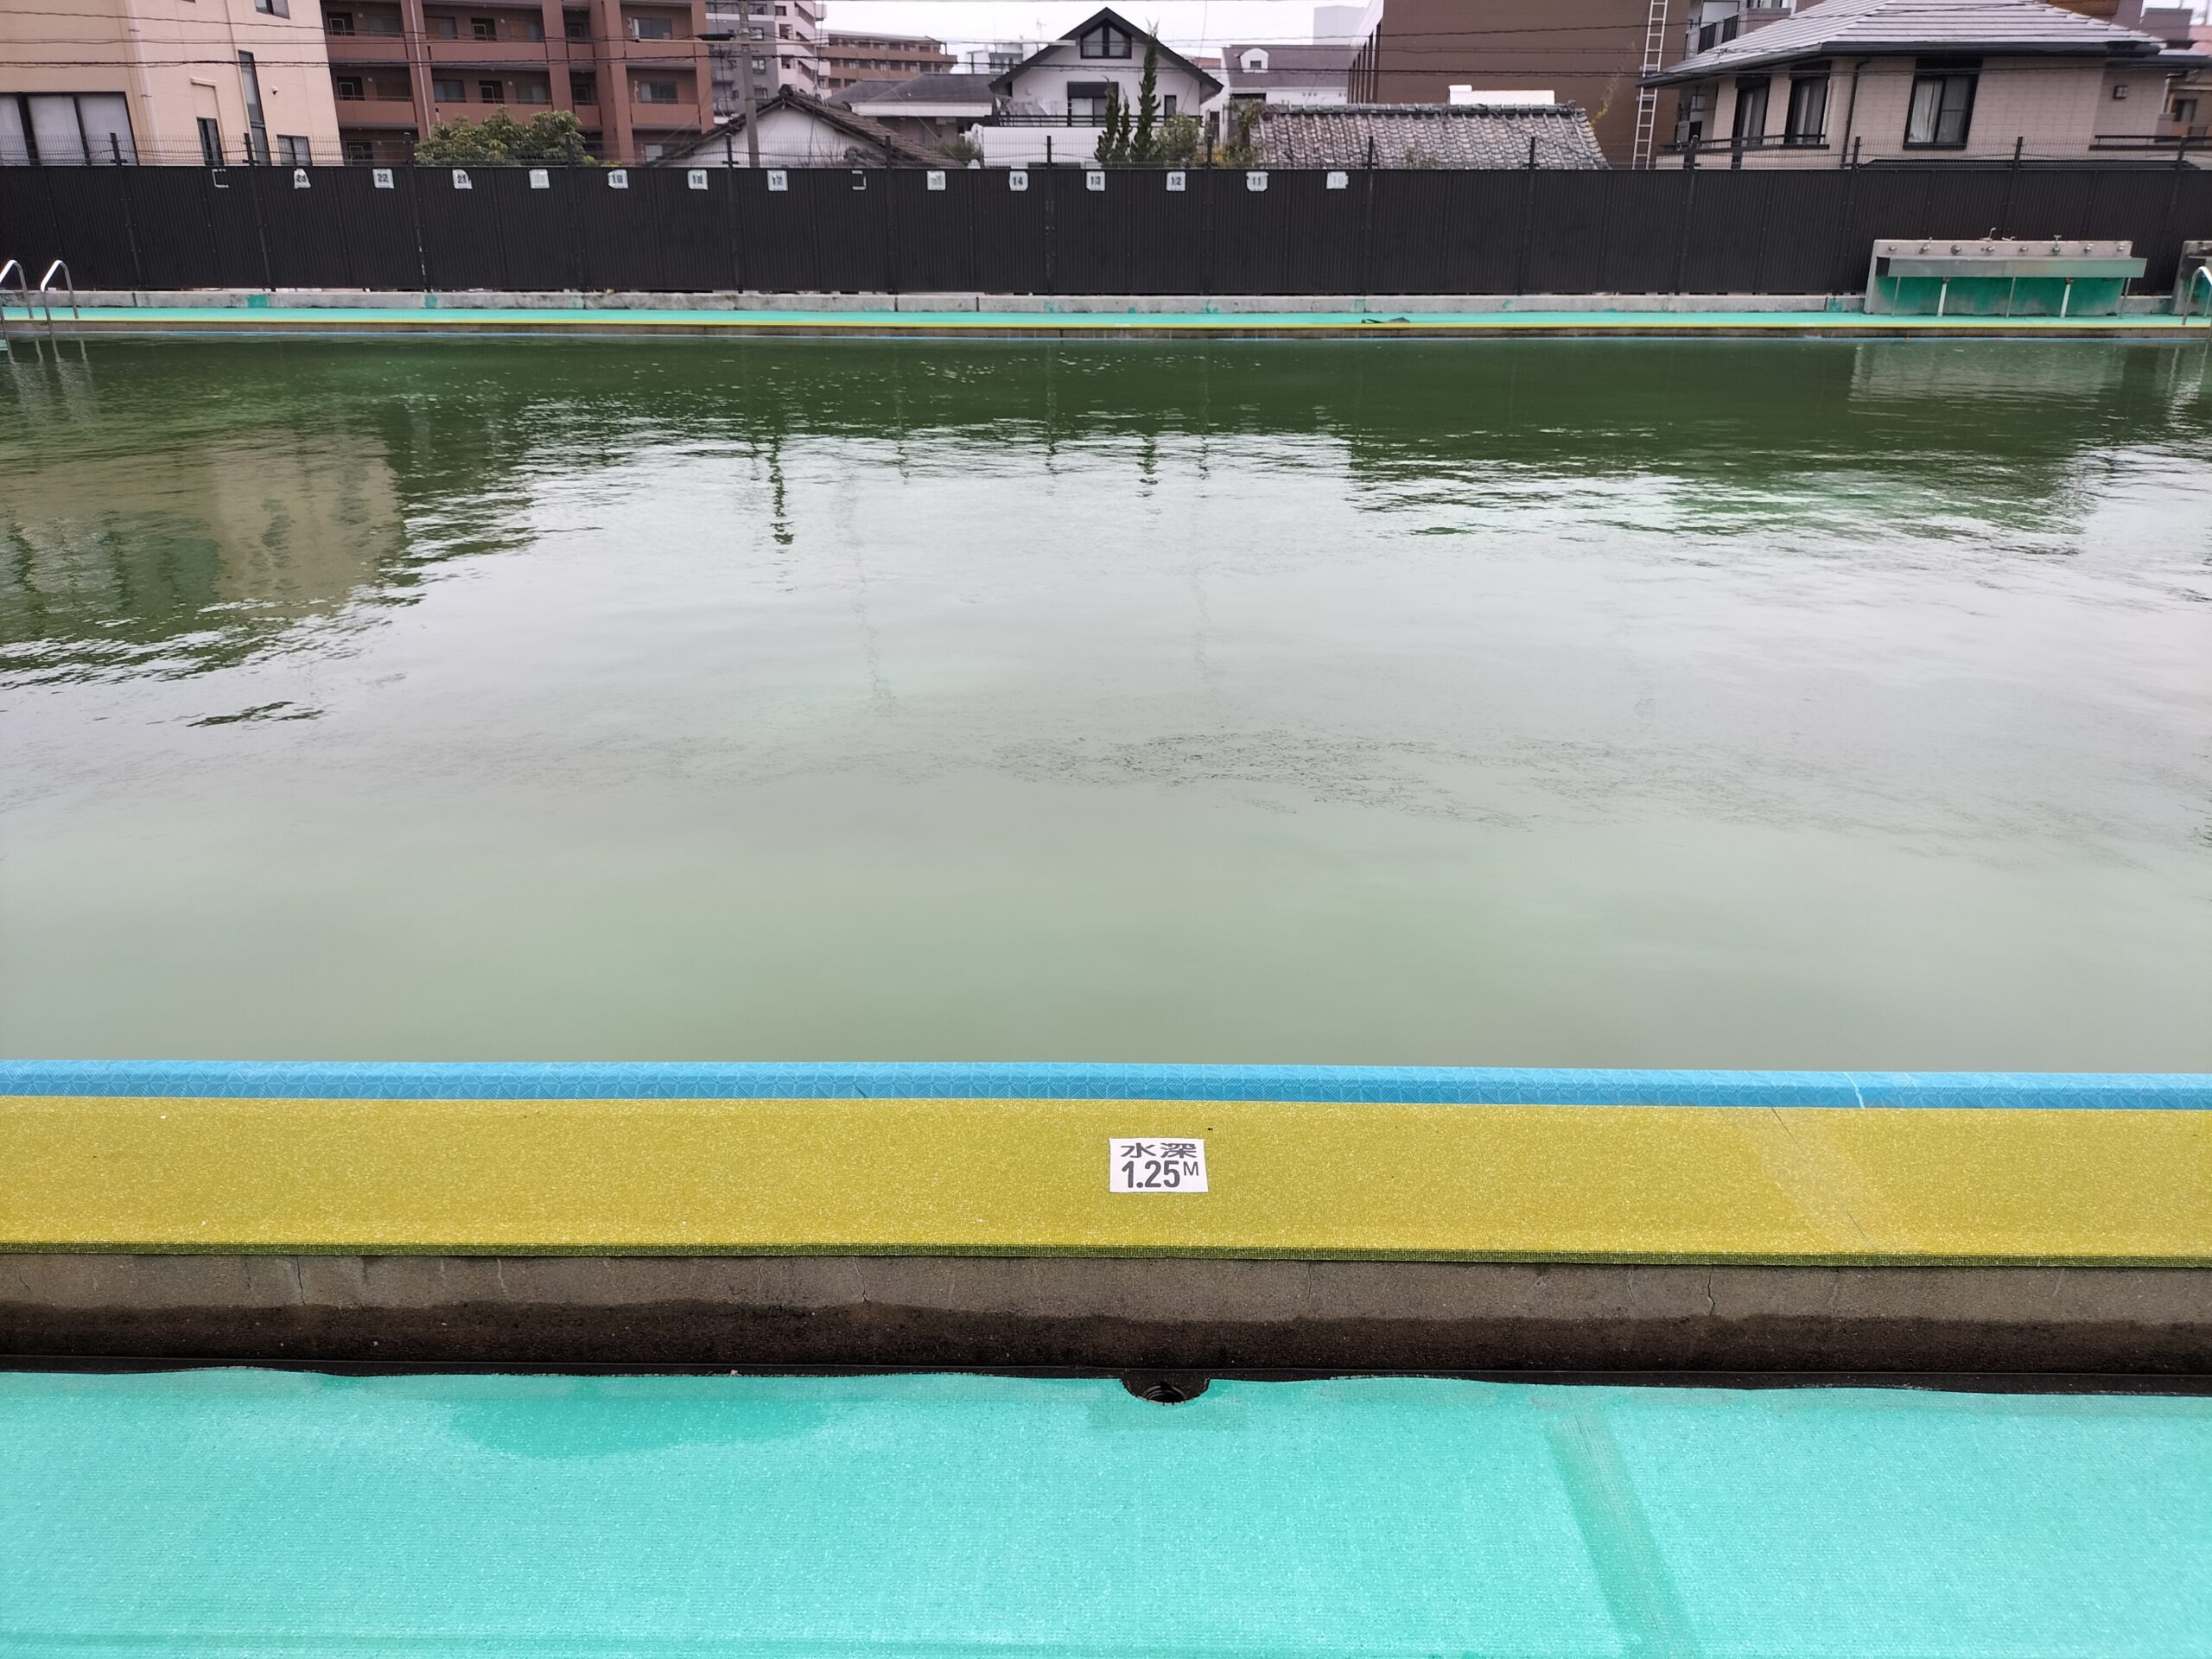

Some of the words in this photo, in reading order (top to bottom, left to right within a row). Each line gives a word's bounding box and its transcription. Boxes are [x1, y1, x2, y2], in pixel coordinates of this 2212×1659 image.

[378, 174, 388, 182] 22
[457, 175, 467, 183] 21
[1172, 176, 1181, 186] 12
[1253, 177, 1261, 186] 11
[1120, 1142, 1197, 1159] 水深
